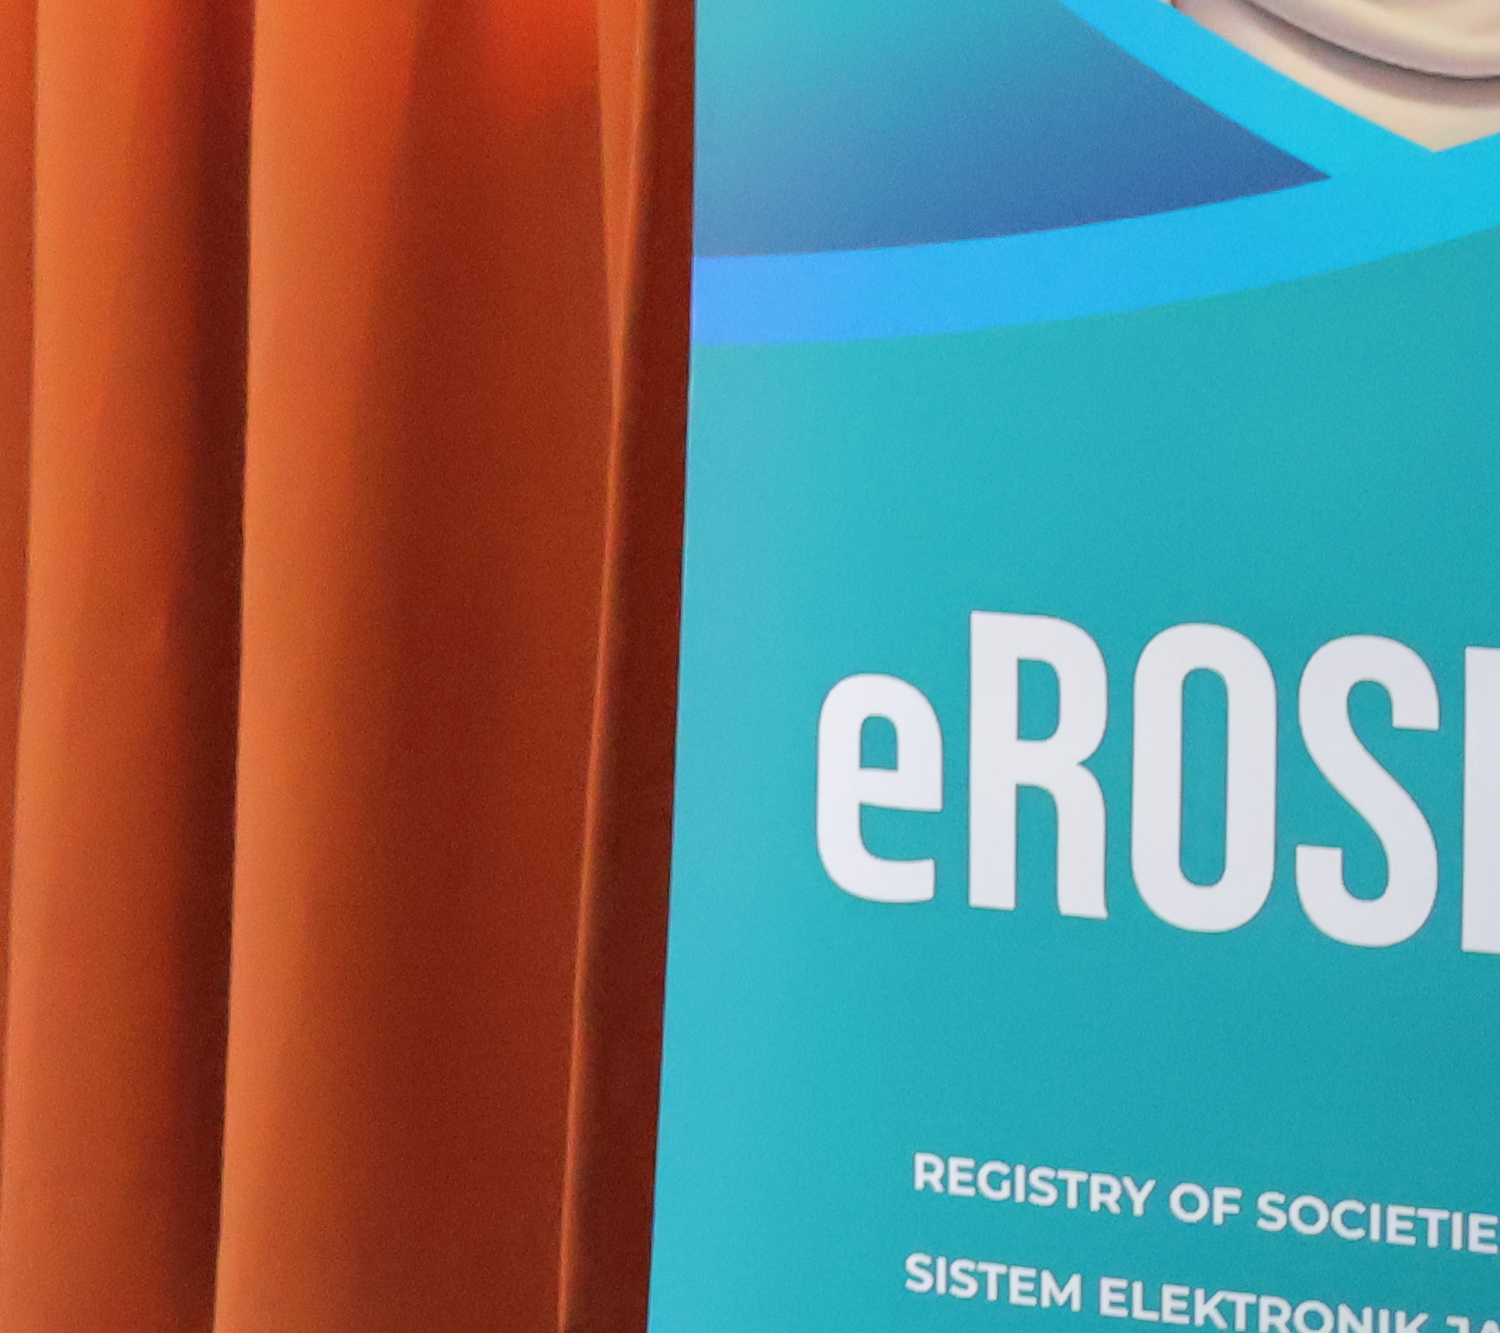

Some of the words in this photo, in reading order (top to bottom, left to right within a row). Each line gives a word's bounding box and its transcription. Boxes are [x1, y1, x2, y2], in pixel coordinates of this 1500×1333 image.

[914, 1152, 1155, 1215] REGISTRY
[1169, 1181, 1242, 1225] OF
[904, 1252, 1081, 1312] SISTEM
[1100, 1276, 1429, 1333] ELEKTRONIK
